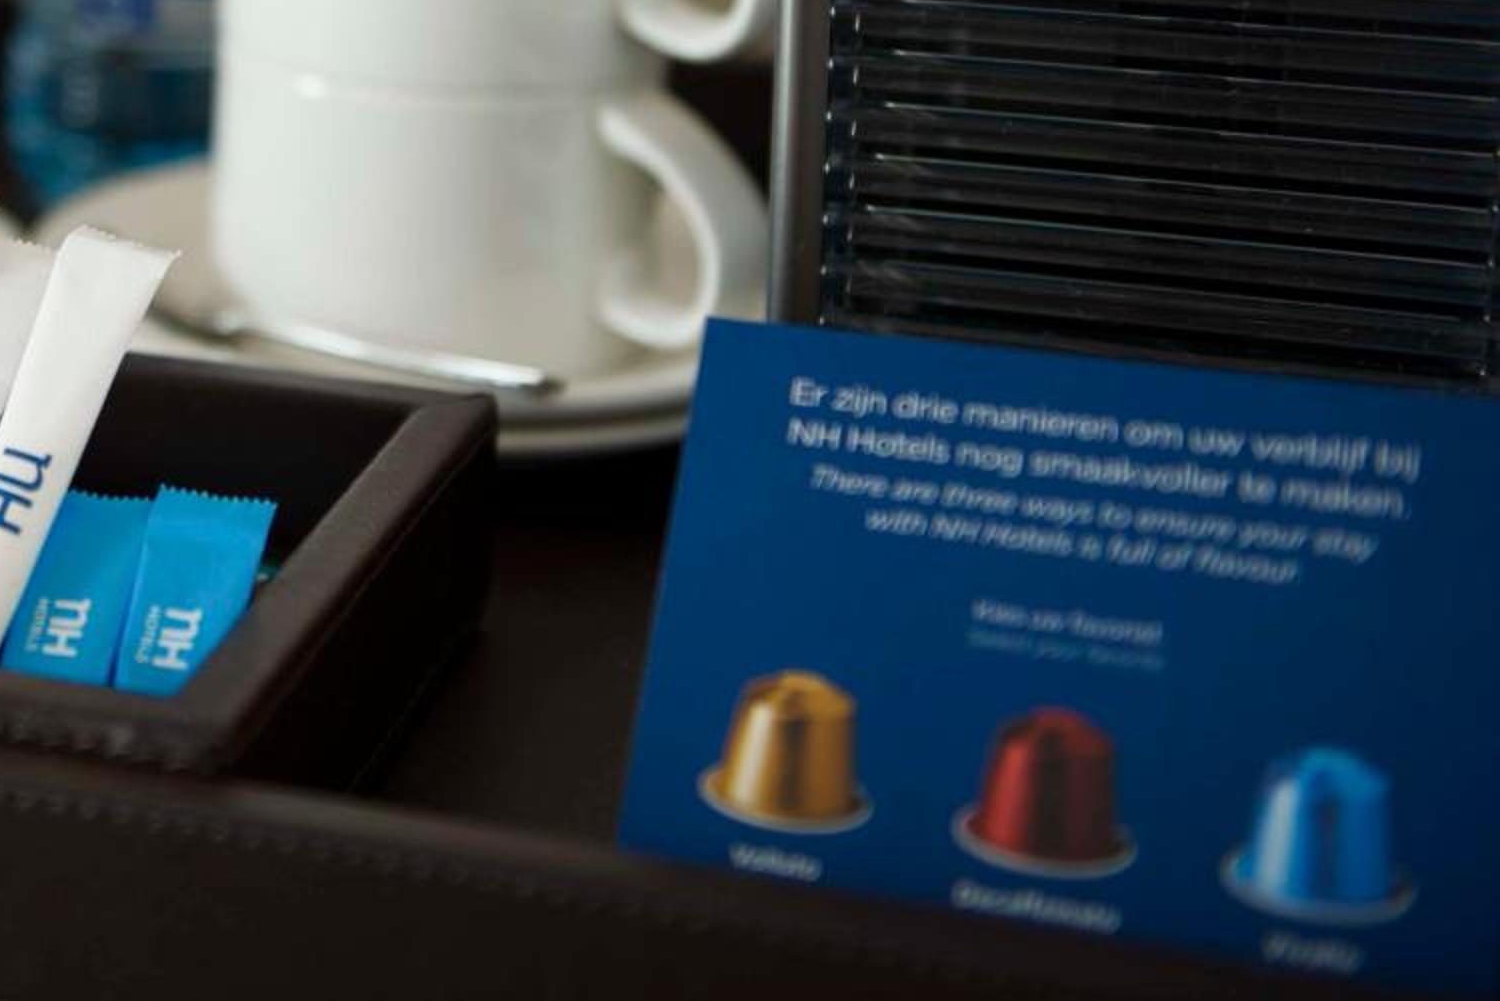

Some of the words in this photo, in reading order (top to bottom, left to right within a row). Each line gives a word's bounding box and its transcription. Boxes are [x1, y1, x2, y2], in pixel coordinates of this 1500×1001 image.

[787, 416, 842, 451] NH
[847, 424, 951, 465] Hotels
[955, 441, 1024, 479] nog
[1027, 451, 1232, 498] smaakvoller
[1236, 470, 1277, 504] te
[789, 375, 828, 408] Er
[831, 385, 887, 419] zijn
[890, 391, 959, 424] drie
[963, 401, 1119, 441] manieren
[1123, 419, 1183, 451] om
[1188, 427, 1246, 458] uw
[1251, 431, 1371, 474] verblijf
[1373, 439, 1422, 485] bij
[810, 463, 890, 498] There
[891, 478, 940, 505] are
[941, 481, 1019, 515] three
[1019, 496, 1094, 525] ways
[1098, 500, 1133, 529] to
[1133, 507, 1237, 543] ensure
[1237, 520, 1309, 549] your
[1311, 527, 1380, 565] stay
[865, 507, 928, 535] with
[931, 512, 983, 542] NH
[979, 519, 1074, 557] Hotels
[1077, 533, 1104, 561] is
[1105, 533, 1158, 565] full
[1155, 541, 1194, 570] of
